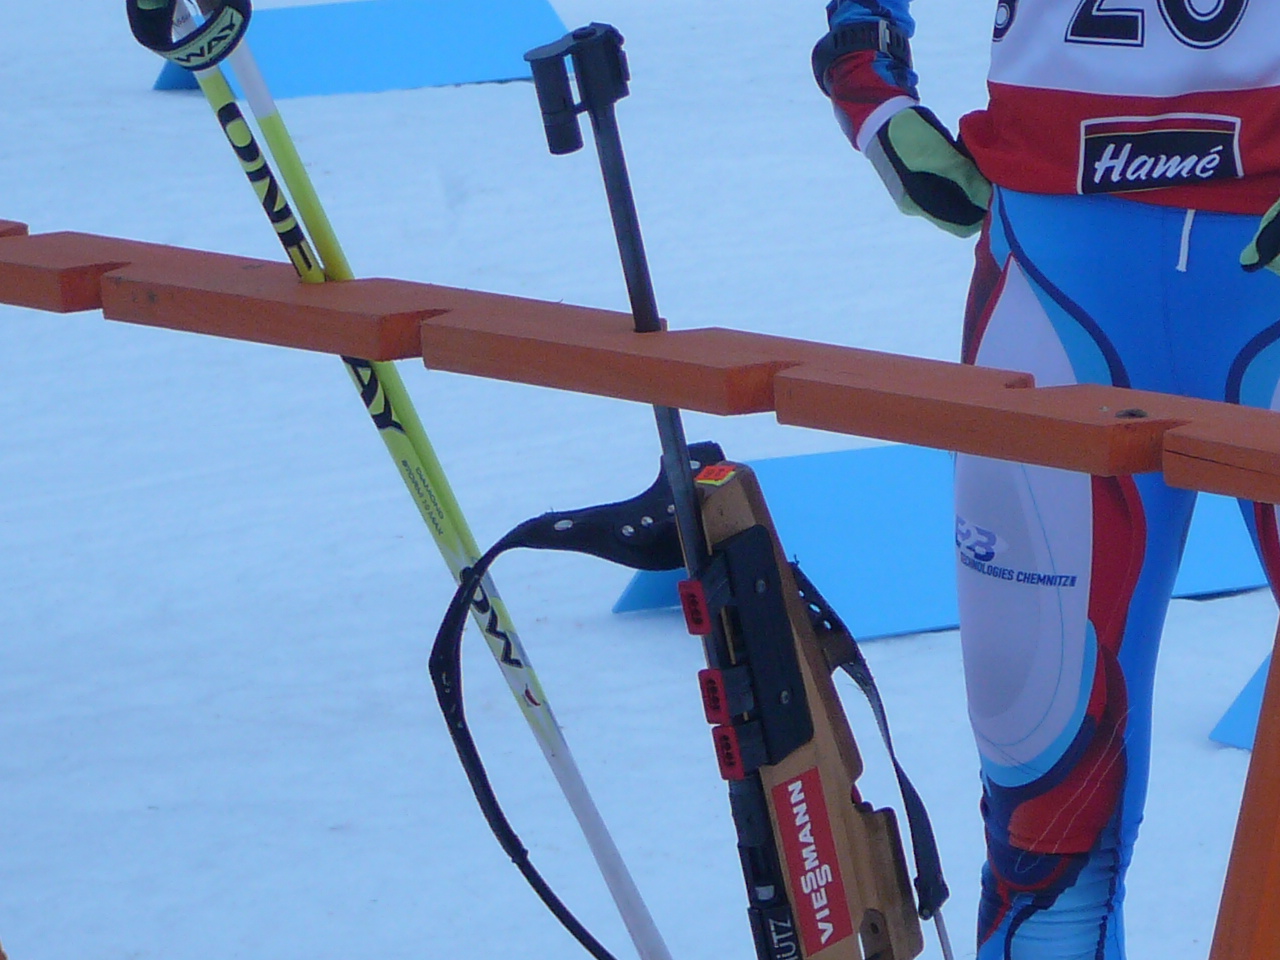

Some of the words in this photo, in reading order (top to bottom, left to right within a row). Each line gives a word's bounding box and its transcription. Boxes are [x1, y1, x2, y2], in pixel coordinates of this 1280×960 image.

[174, 11, 237, 64] WAY
[1093, 142, 1224, 184] Hamé
[415, 467, 444, 520] DIAMOND
[1016, 571, 1070, 587] CHEMNITZ
[787, 779, 836, 946] VIESSMANN
[767, 916, 792, 960] ÜTZ
